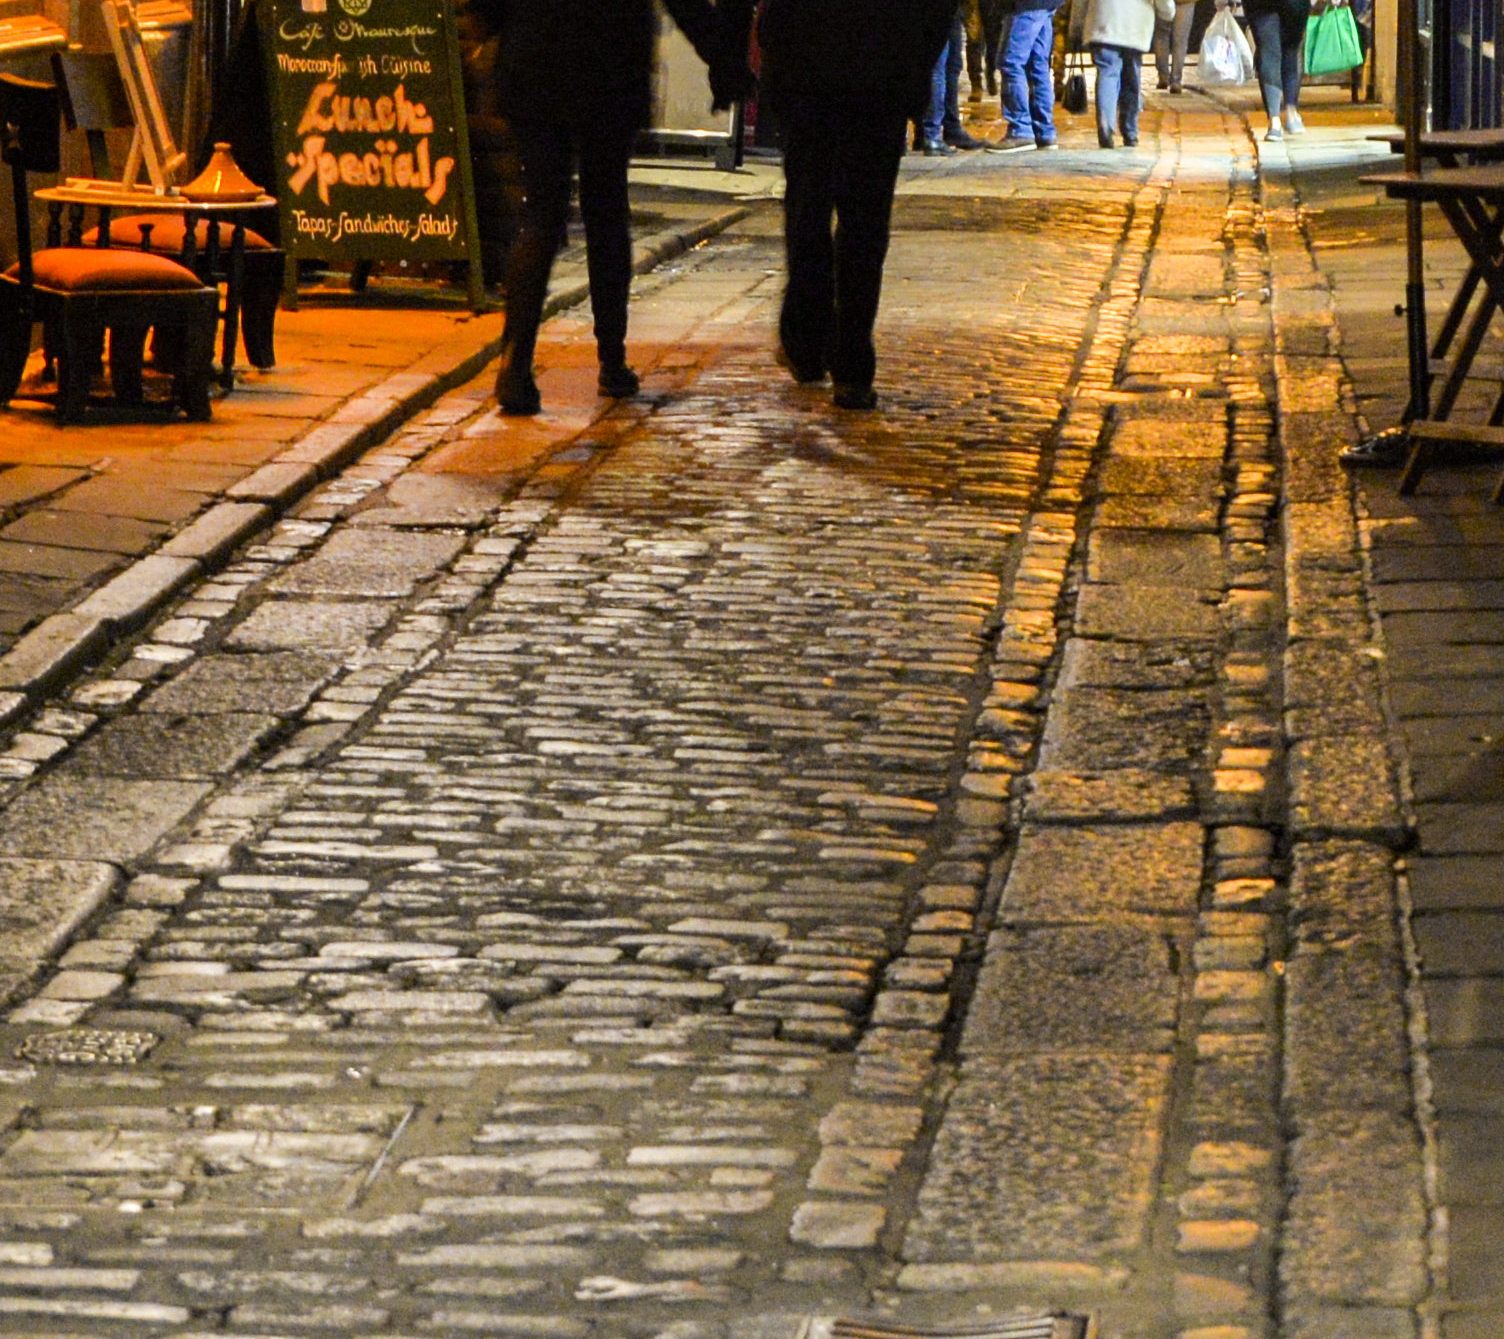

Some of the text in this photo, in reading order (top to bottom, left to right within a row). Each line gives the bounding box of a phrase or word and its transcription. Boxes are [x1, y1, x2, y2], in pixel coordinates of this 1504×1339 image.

[279, 18, 324, 50] Café
[297, 81, 434, 135] Lunch
[285, 134, 455, 206] Specials
